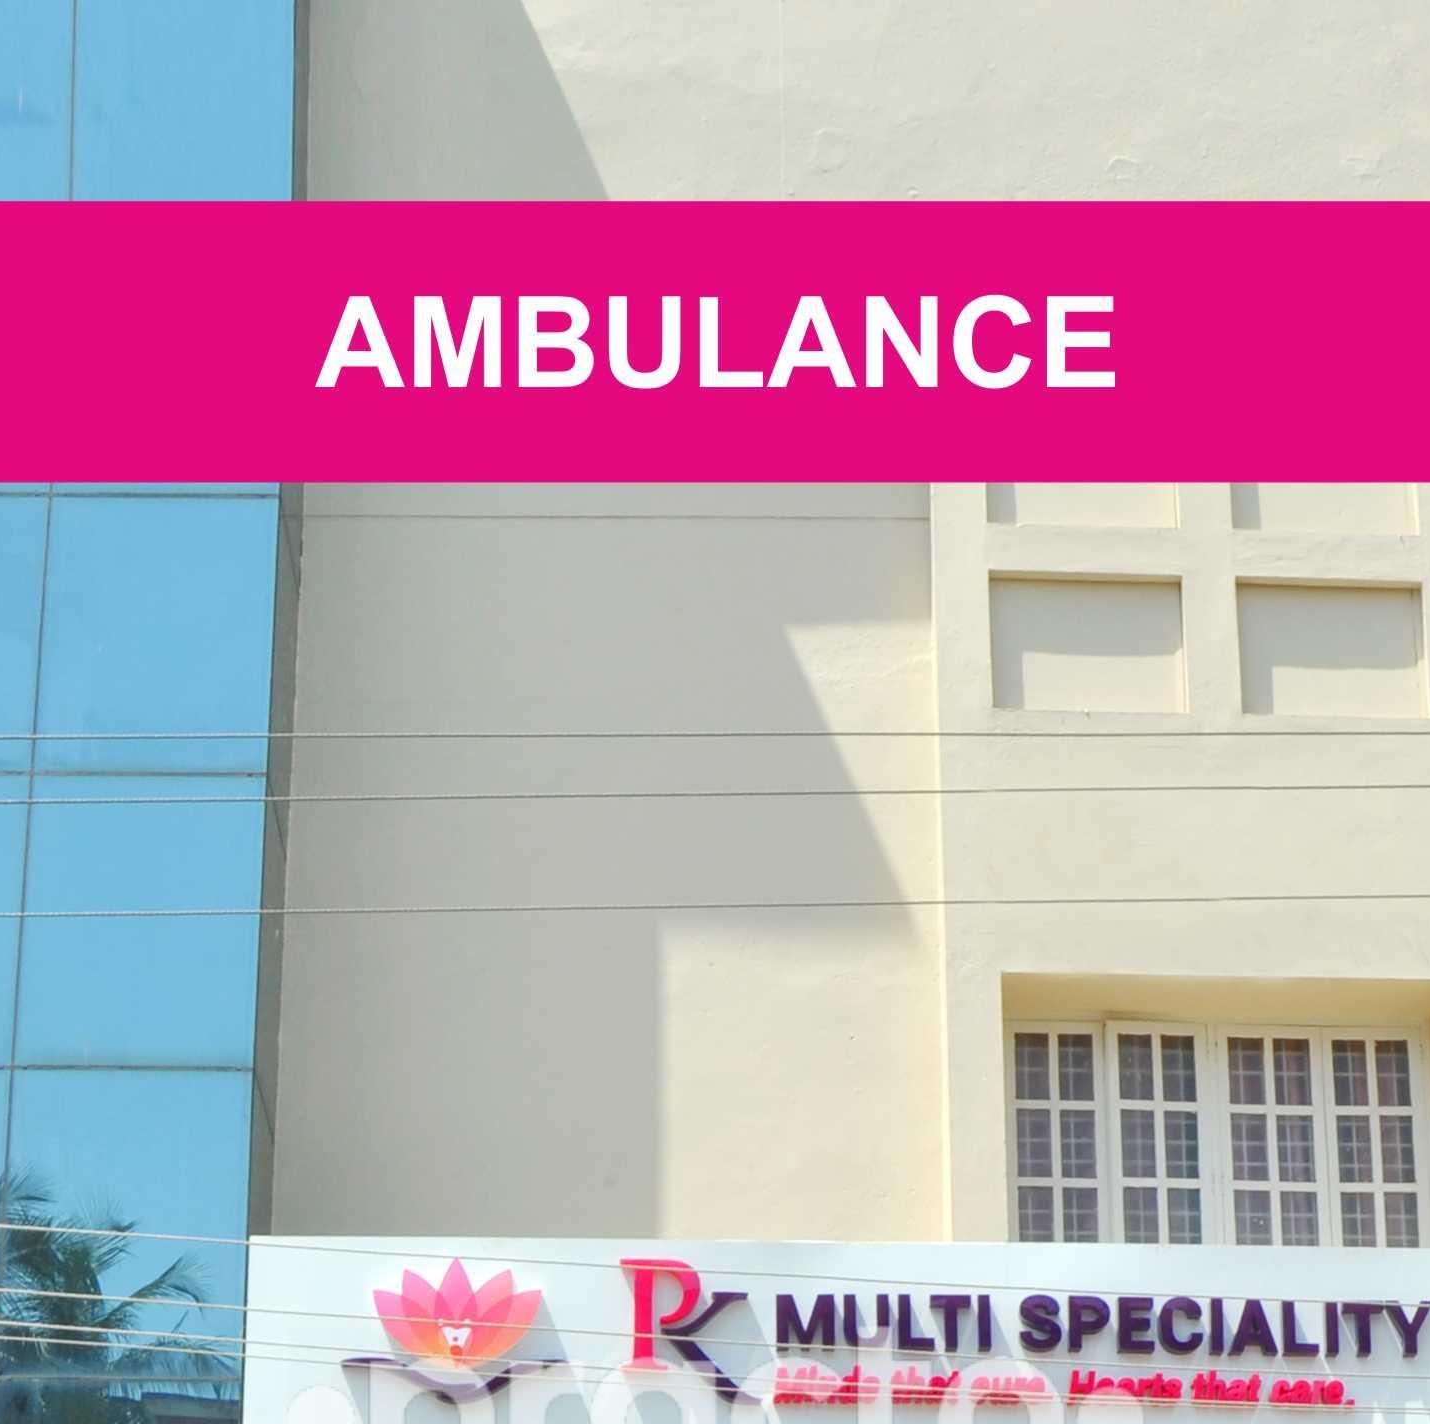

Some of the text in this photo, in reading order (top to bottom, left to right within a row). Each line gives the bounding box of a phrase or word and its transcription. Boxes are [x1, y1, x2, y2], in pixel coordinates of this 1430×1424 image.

[775, 1293, 993, 1352] MULTI
[890, 1365, 963, 1405] that
[1067, 1369, 1183, 1407] Hearts
[1190, 1369, 1263, 1407] that
[1269, 1377, 1356, 1408] care.
